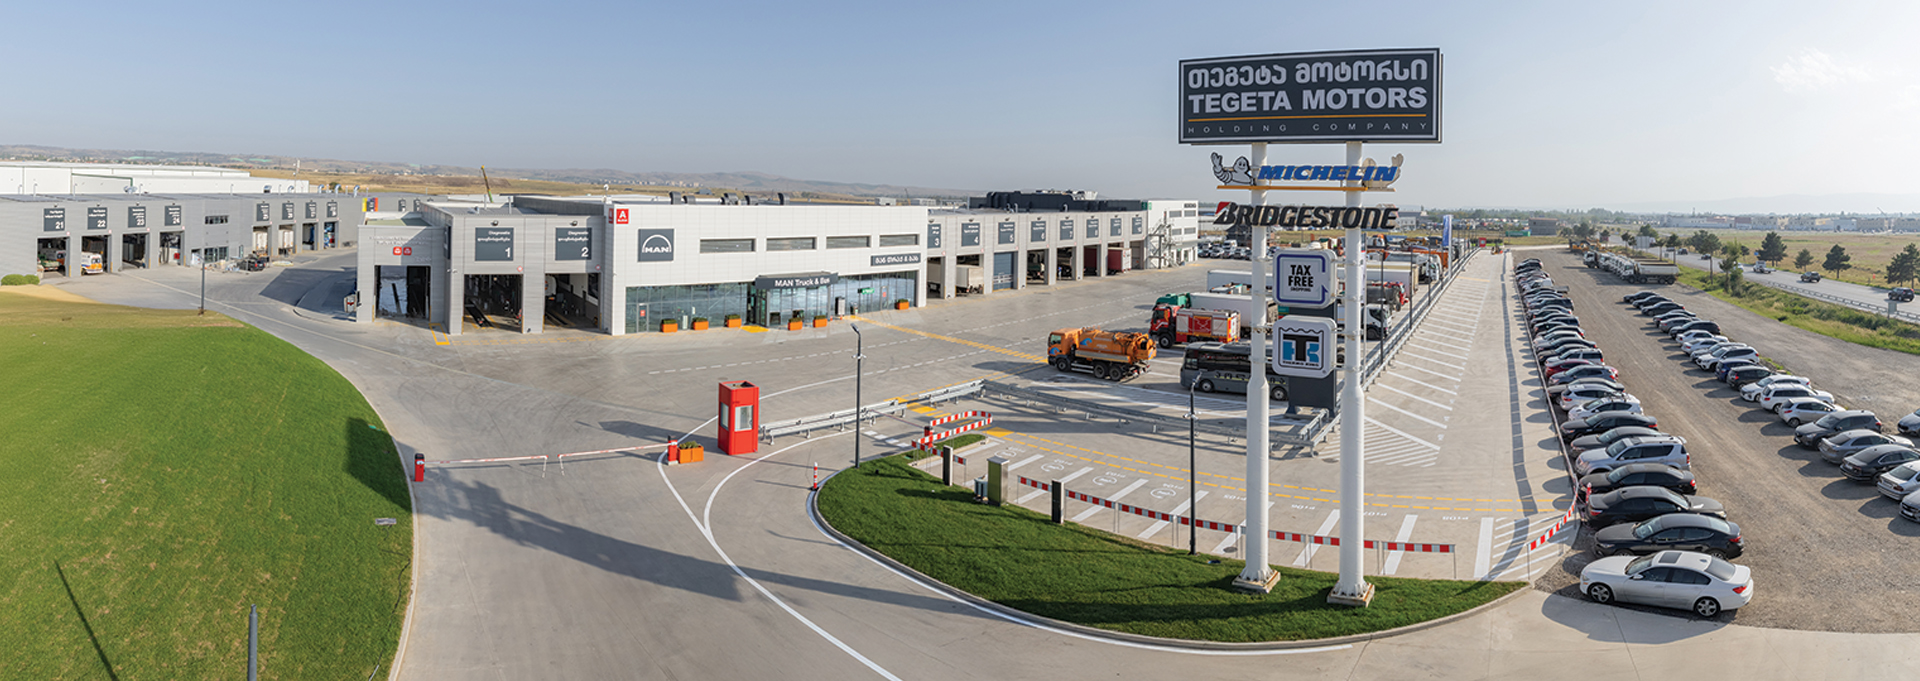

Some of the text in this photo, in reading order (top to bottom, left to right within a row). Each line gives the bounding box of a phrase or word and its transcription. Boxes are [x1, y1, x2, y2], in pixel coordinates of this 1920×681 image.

[1188, 59, 1428, 89] თეგეტა მოტორსი
[1188, 87, 1428, 113] TEGETA MOTORS
[1188, 122, 1427, 134] HOLDING COMPANY
[1257, 165, 1398, 181] MICHELIN
[619, 210, 626, 218] A
[1213, 201, 1399, 230] BRIDGESTONE
[55, 221, 64, 229] 21
[97, 219, 106, 227] 22
[934, 238, 940, 246] 3
[505, 247, 511, 258] 1
[581, 246, 589, 257] 2
[1290, 264, 1311, 276] TAX
[774, 279, 794, 287] MAN
[795, 278, 814, 286] Truck
[820, 277, 830, 285] Bus
[1288, 276, 1314, 287] FREE
